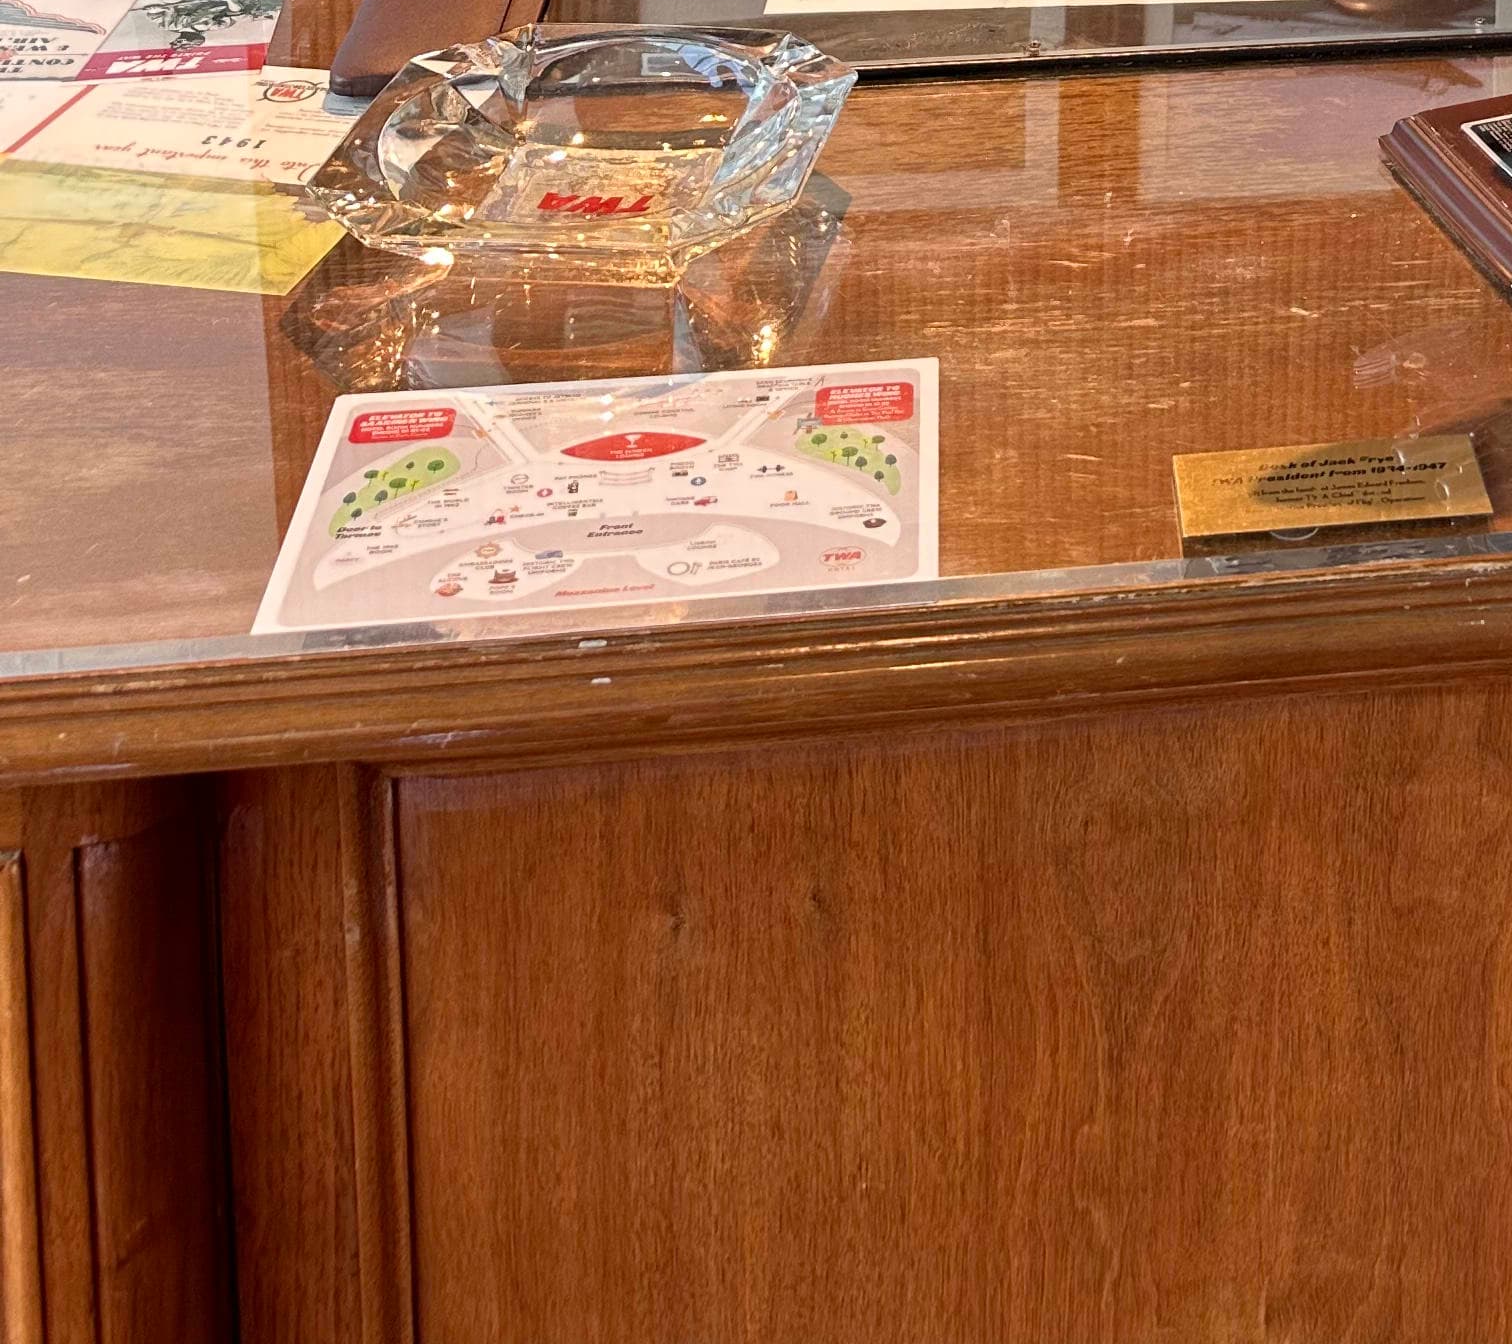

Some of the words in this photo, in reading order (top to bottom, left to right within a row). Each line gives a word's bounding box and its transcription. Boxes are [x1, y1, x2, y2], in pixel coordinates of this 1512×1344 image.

[105, 56, 205, 74] TWA
[272, 85, 306, 100] TWA
[141, 146, 227, 164] important
[240, 157, 270, 171] this
[537, 192, 655, 215] TWA
[1318, 457, 1356, 467] Jack
[1329, 468, 1367, 477] from
[337, 525, 368, 533] Door
[599, 523, 634, 531] Front
[335, 531, 382, 540] Tarmac
[586, 529, 644, 538] Entrance
[823, 550, 862, 562] TWA
[554, 587, 621, 598] Mezzanine
[622, 583, 656, 593] Level
